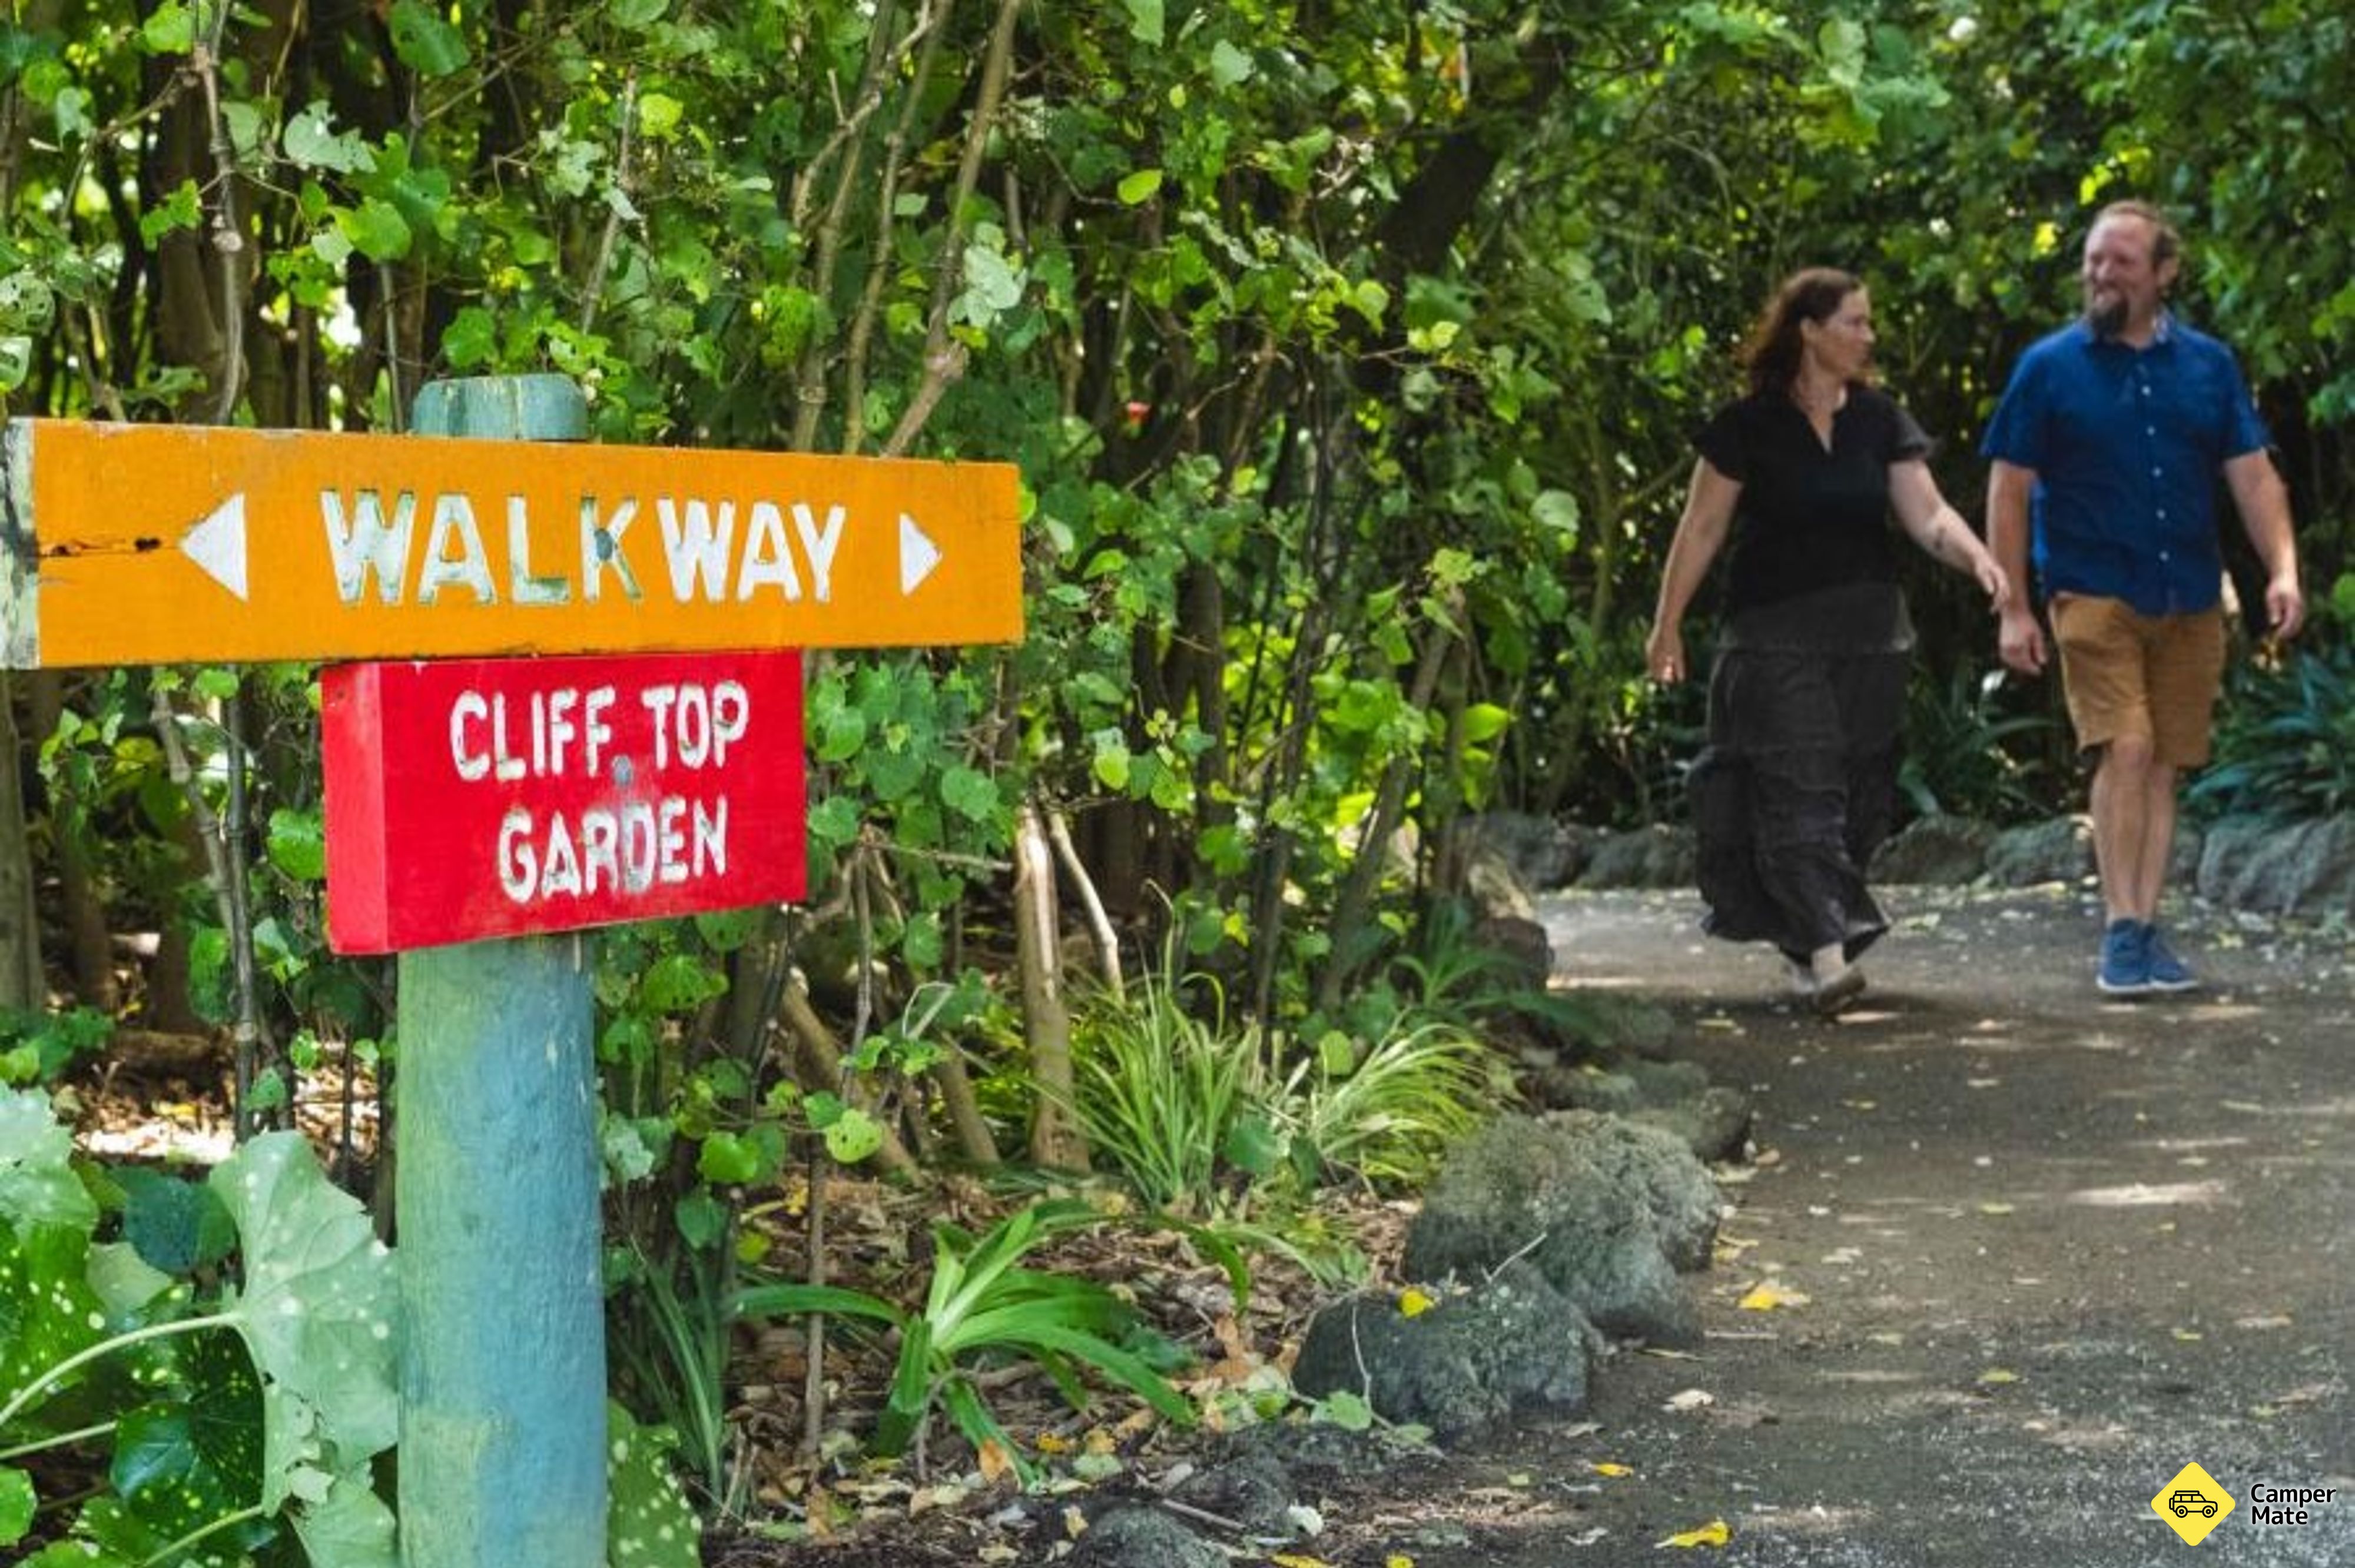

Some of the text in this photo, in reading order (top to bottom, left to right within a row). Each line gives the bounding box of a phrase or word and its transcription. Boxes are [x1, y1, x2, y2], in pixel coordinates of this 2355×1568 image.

[319, 489, 845, 606] WALKWAY
[449, 679, 749, 782] CLIFF TOP
[497, 793, 728, 903] GARDEN
